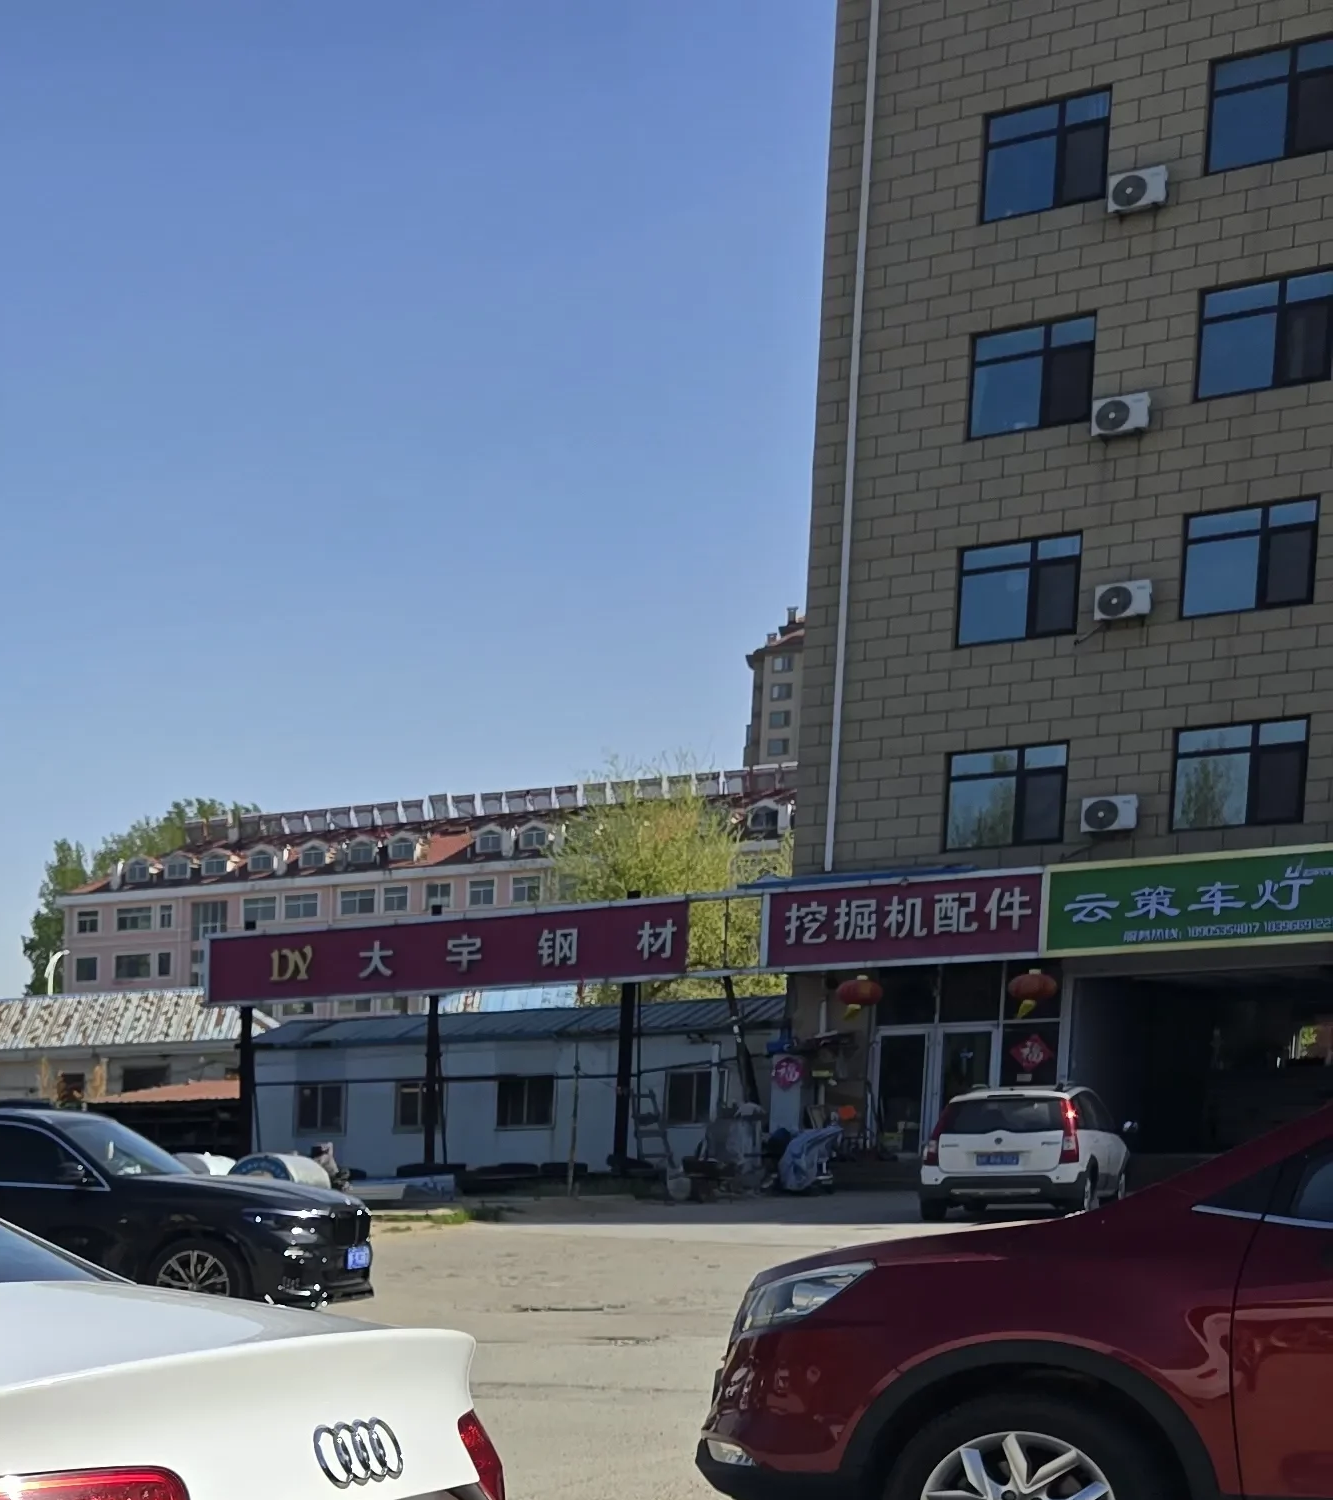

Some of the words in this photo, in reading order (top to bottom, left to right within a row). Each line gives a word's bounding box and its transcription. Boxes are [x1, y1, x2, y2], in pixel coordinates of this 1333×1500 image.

[785, 886, 1033, 946] 挖掘机配件
[1064, 878, 1314, 924] 云策车灯
[269, 944, 314, 982] DY
[358, 918, 678, 980] 大宇钢材
[776, 1061, 800, 1082] 福
[1019, 1040, 1044, 1064] 福
